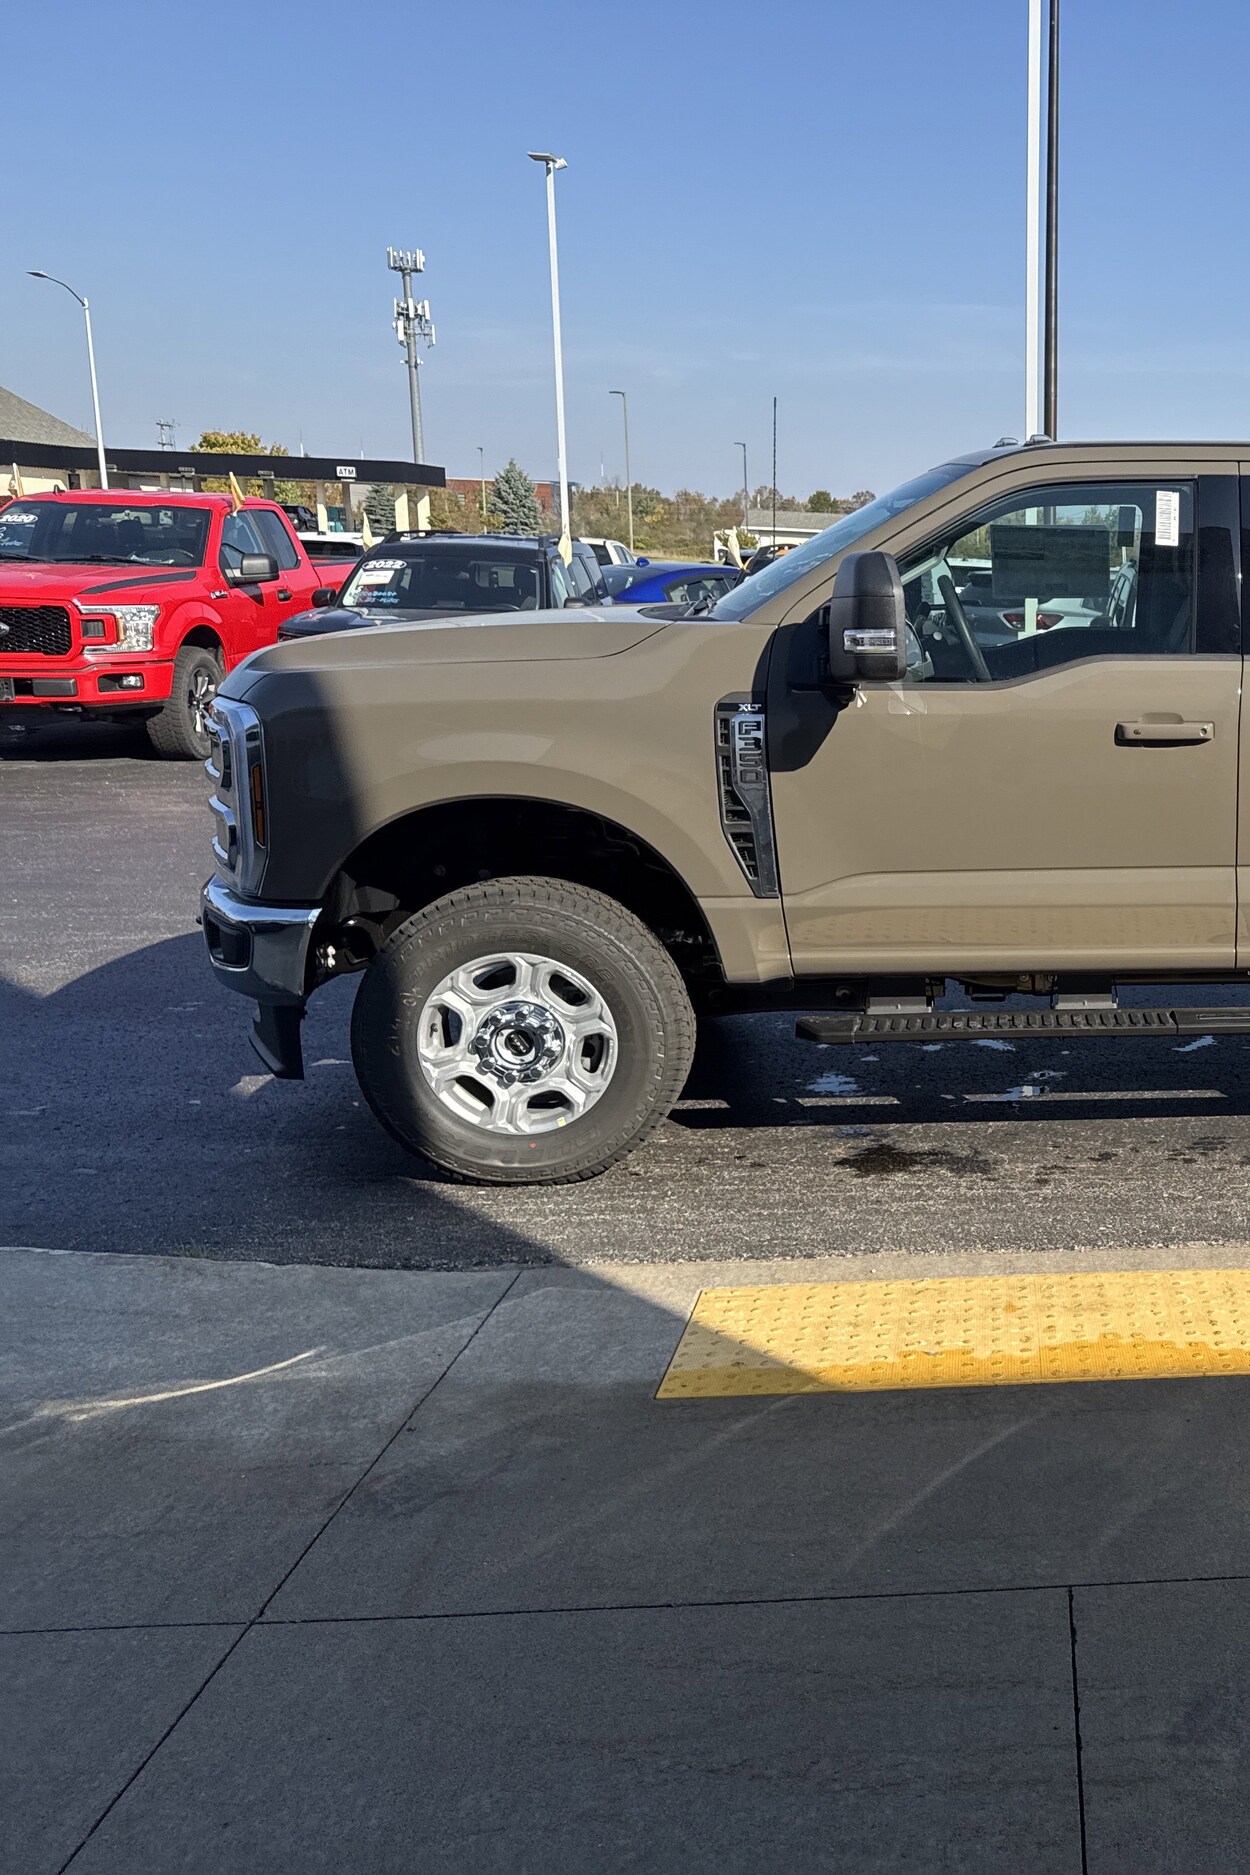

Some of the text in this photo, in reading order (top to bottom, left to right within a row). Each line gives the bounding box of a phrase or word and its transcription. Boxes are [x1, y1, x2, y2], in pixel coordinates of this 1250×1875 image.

[338, 468, 355, 476] ATM
[366, 560, 402, 569] 2022
[738, 703, 762, 712] XLT
